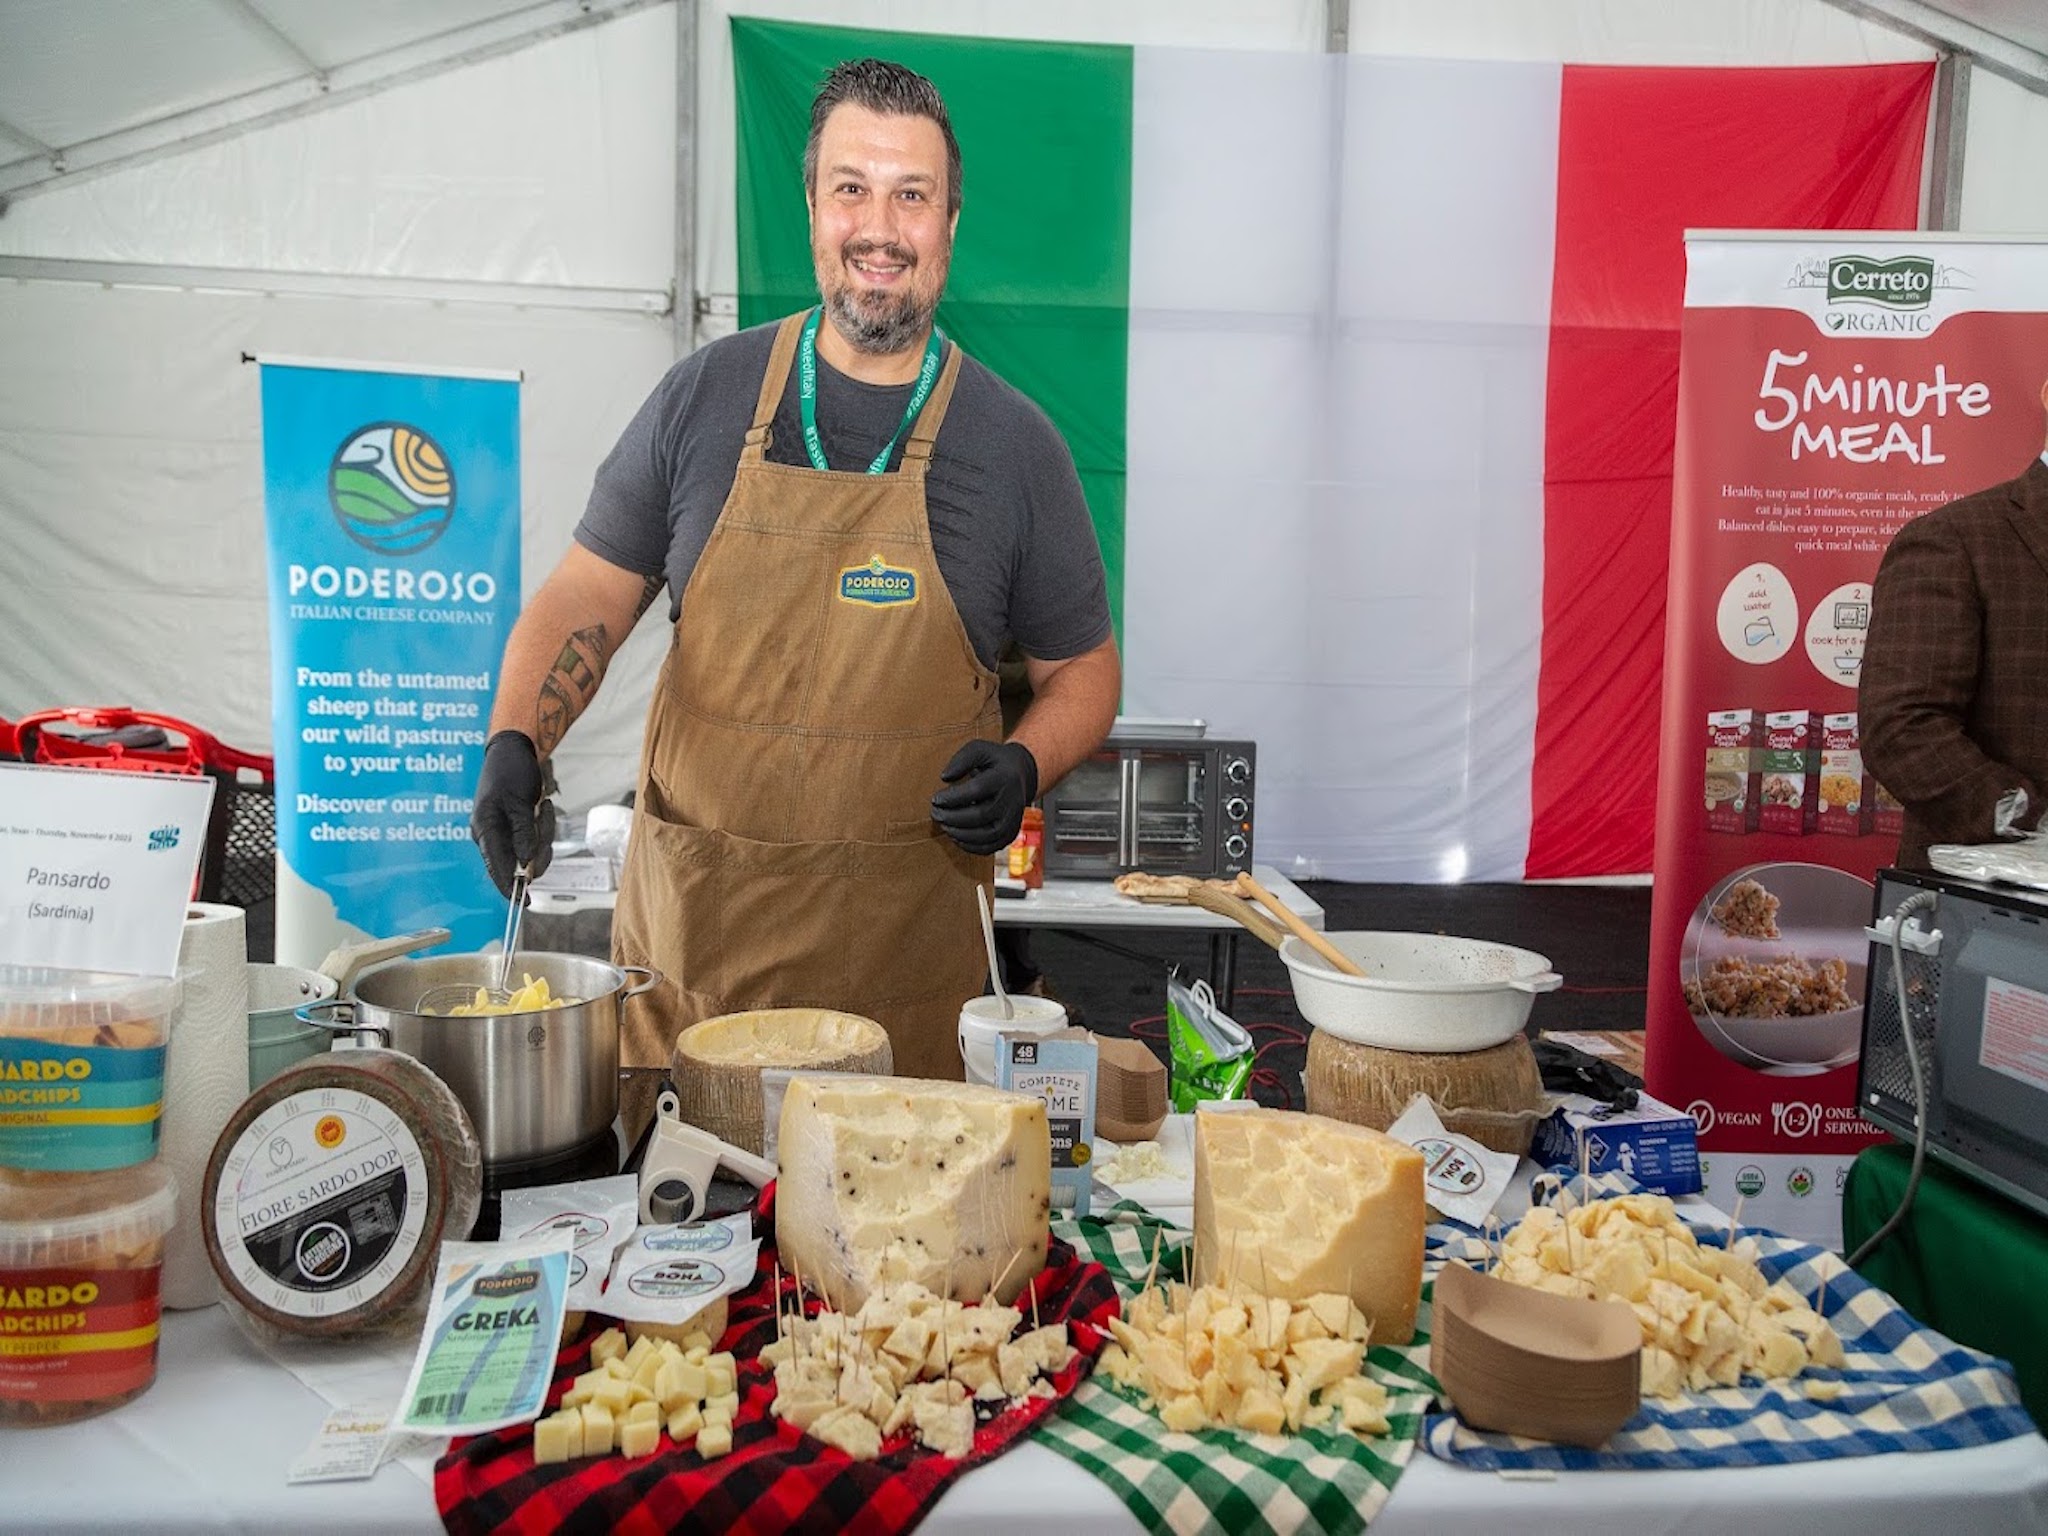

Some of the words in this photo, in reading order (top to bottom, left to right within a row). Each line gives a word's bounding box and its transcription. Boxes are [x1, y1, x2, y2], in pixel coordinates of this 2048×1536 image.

[1831, 262, 1930, 292] Cerreto
[1754, 349, 1808, 432] 5
[1792, 421, 1946, 466] MEAL
[1722, 485, 1764, 500] Healthy,
[1766, 488, 1787, 501] tasty
[1789, 487, 1809, 499] and
[1813, 487, 1843, 499] 100%
[1845, 489, 1884, 502] organic
[1886, 490, 1917, 502] meals,
[1920, 490, 1949, 505] ready
[1755, 504, 1770, 515] eat
[1772, 503, 1782, 515] in
[1783, 504, 1801, 518] just
[1804, 504, 1811, 516] 5
[1814, 505, 1857, 517] minutes,
[1860, 508, 1883, 517] even
[1885, 506, 1895, 517] in
[1897, 507, 1915, 518] the
[1719, 519, 1764, 532] Balanced
[1766, 520, 1796, 533] dishes
[1797, 524, 1819, 536] easy
[1822, 524, 1833, 533] to
[1835, 525, 1878, 538] prepare,
[1794, 539, 1824, 553] quick
[1826, 540, 1852, 551] meal
[1854, 540, 1881, 551] while
[288, 565, 496, 603] PODEROSO
[1747, 590, 1767, 599] add
[290, 604, 351, 620] ITALIAN
[355, 606, 416, 622] CHEESE
[418, 609, 496, 625] COMPANY
[1743, 601, 1772, 612] water
[1811, 635, 1833, 645] cook
[1834, 634, 1849, 651] for
[297, 667, 353, 688] From
[358, 668, 391, 689] the
[397, 671, 490, 691] untamed
[307, 696, 370, 720] sheep
[374, 697, 418, 718] that
[422, 701, 479, 722] graze
[302, 727, 339, 743] our
[344, 724, 390, 744] wild
[395, 728, 485, 748] pastures
[323, 754, 346, 772] to
[350, 756, 401, 776] your
[405, 753, 464, 773] table!
[297, 793, 387, 814] Discover
[391, 798, 429, 814] our
[310, 821, 381, 842] cheese
[26, 867, 111, 891] Pansardo
[27, 902, 94, 924] (Sardinia)
[1016, 1045, 1034, 1058] 48
[1018, 1076, 1081, 1091] COMPLETE
[1037, 1096, 1081, 1111] OME
[1717, 1111, 1762, 1126] VEGAN
[1787, 1113, 1805, 1126] 1-2
[240, 1197, 296, 1233] FIORE
[299, 1167, 359, 1206] SARDO
[361, 1149, 399, 1178] DOP
[0, 1311, 87, 1333] DCHIPS
[452, 1306, 540, 1332] GREKA
